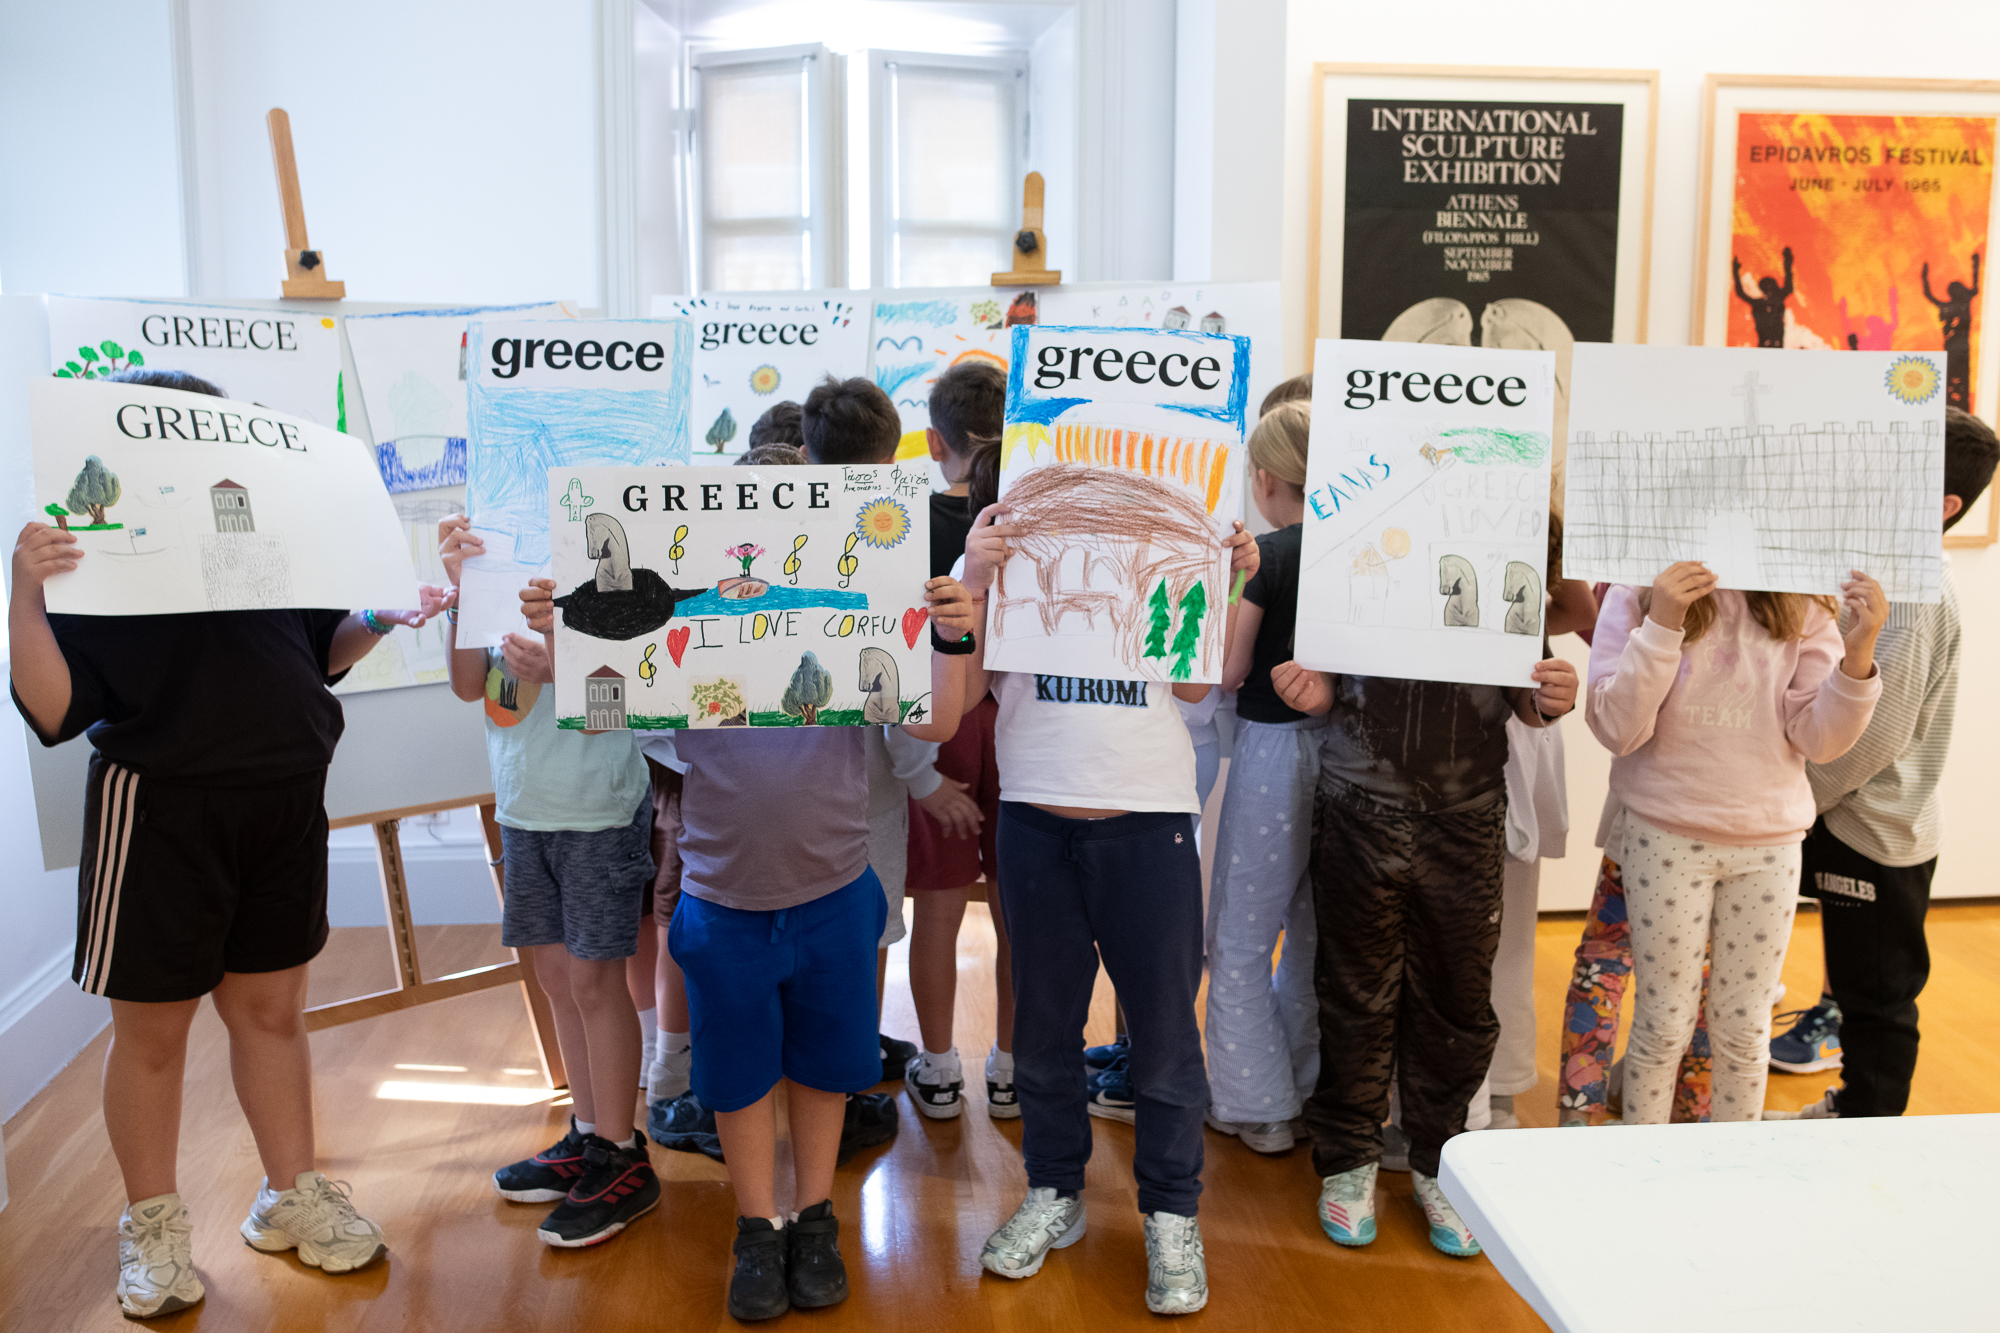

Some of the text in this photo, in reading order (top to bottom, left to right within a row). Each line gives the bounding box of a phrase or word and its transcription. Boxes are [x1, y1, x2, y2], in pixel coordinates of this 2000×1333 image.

[1371, 107, 1598, 136] INTERNATIONAL
[1401, 133, 1566, 160] SCULPTURE
[1749, 145, 1984, 167] EPIDAVROS FESTIVAL
[1402, 159, 1563, 185] EXHIBITION
[1789, 177, 1942, 193] JUNE JULY 1965
[1445, 193, 1520, 212] ATHENS
[1435, 210, 1529, 229] BIENNALE
[1443, 246, 1514, 259] SEPTEMBER
[1504, 231, 1540, 247] HILL)
[1443, 259, 1514, 272] NOVEMBER
[141, 314, 298, 351] GREECE
[700, 321, 819, 350] greece
[491, 337, 665, 379] greece
[1033, 345, 1221, 391] greece
[1343, 369, 1527, 410] greece
[116, 403, 308, 452] GREECE
[622, 482, 831, 513] GREECE
[1441, 470, 1548, 503] GREECE
[690, 612, 897, 650] I LOVE CORFU
[1035, 673, 1149, 708] KUROMI
[1685, 705, 1753, 730] TEAM
